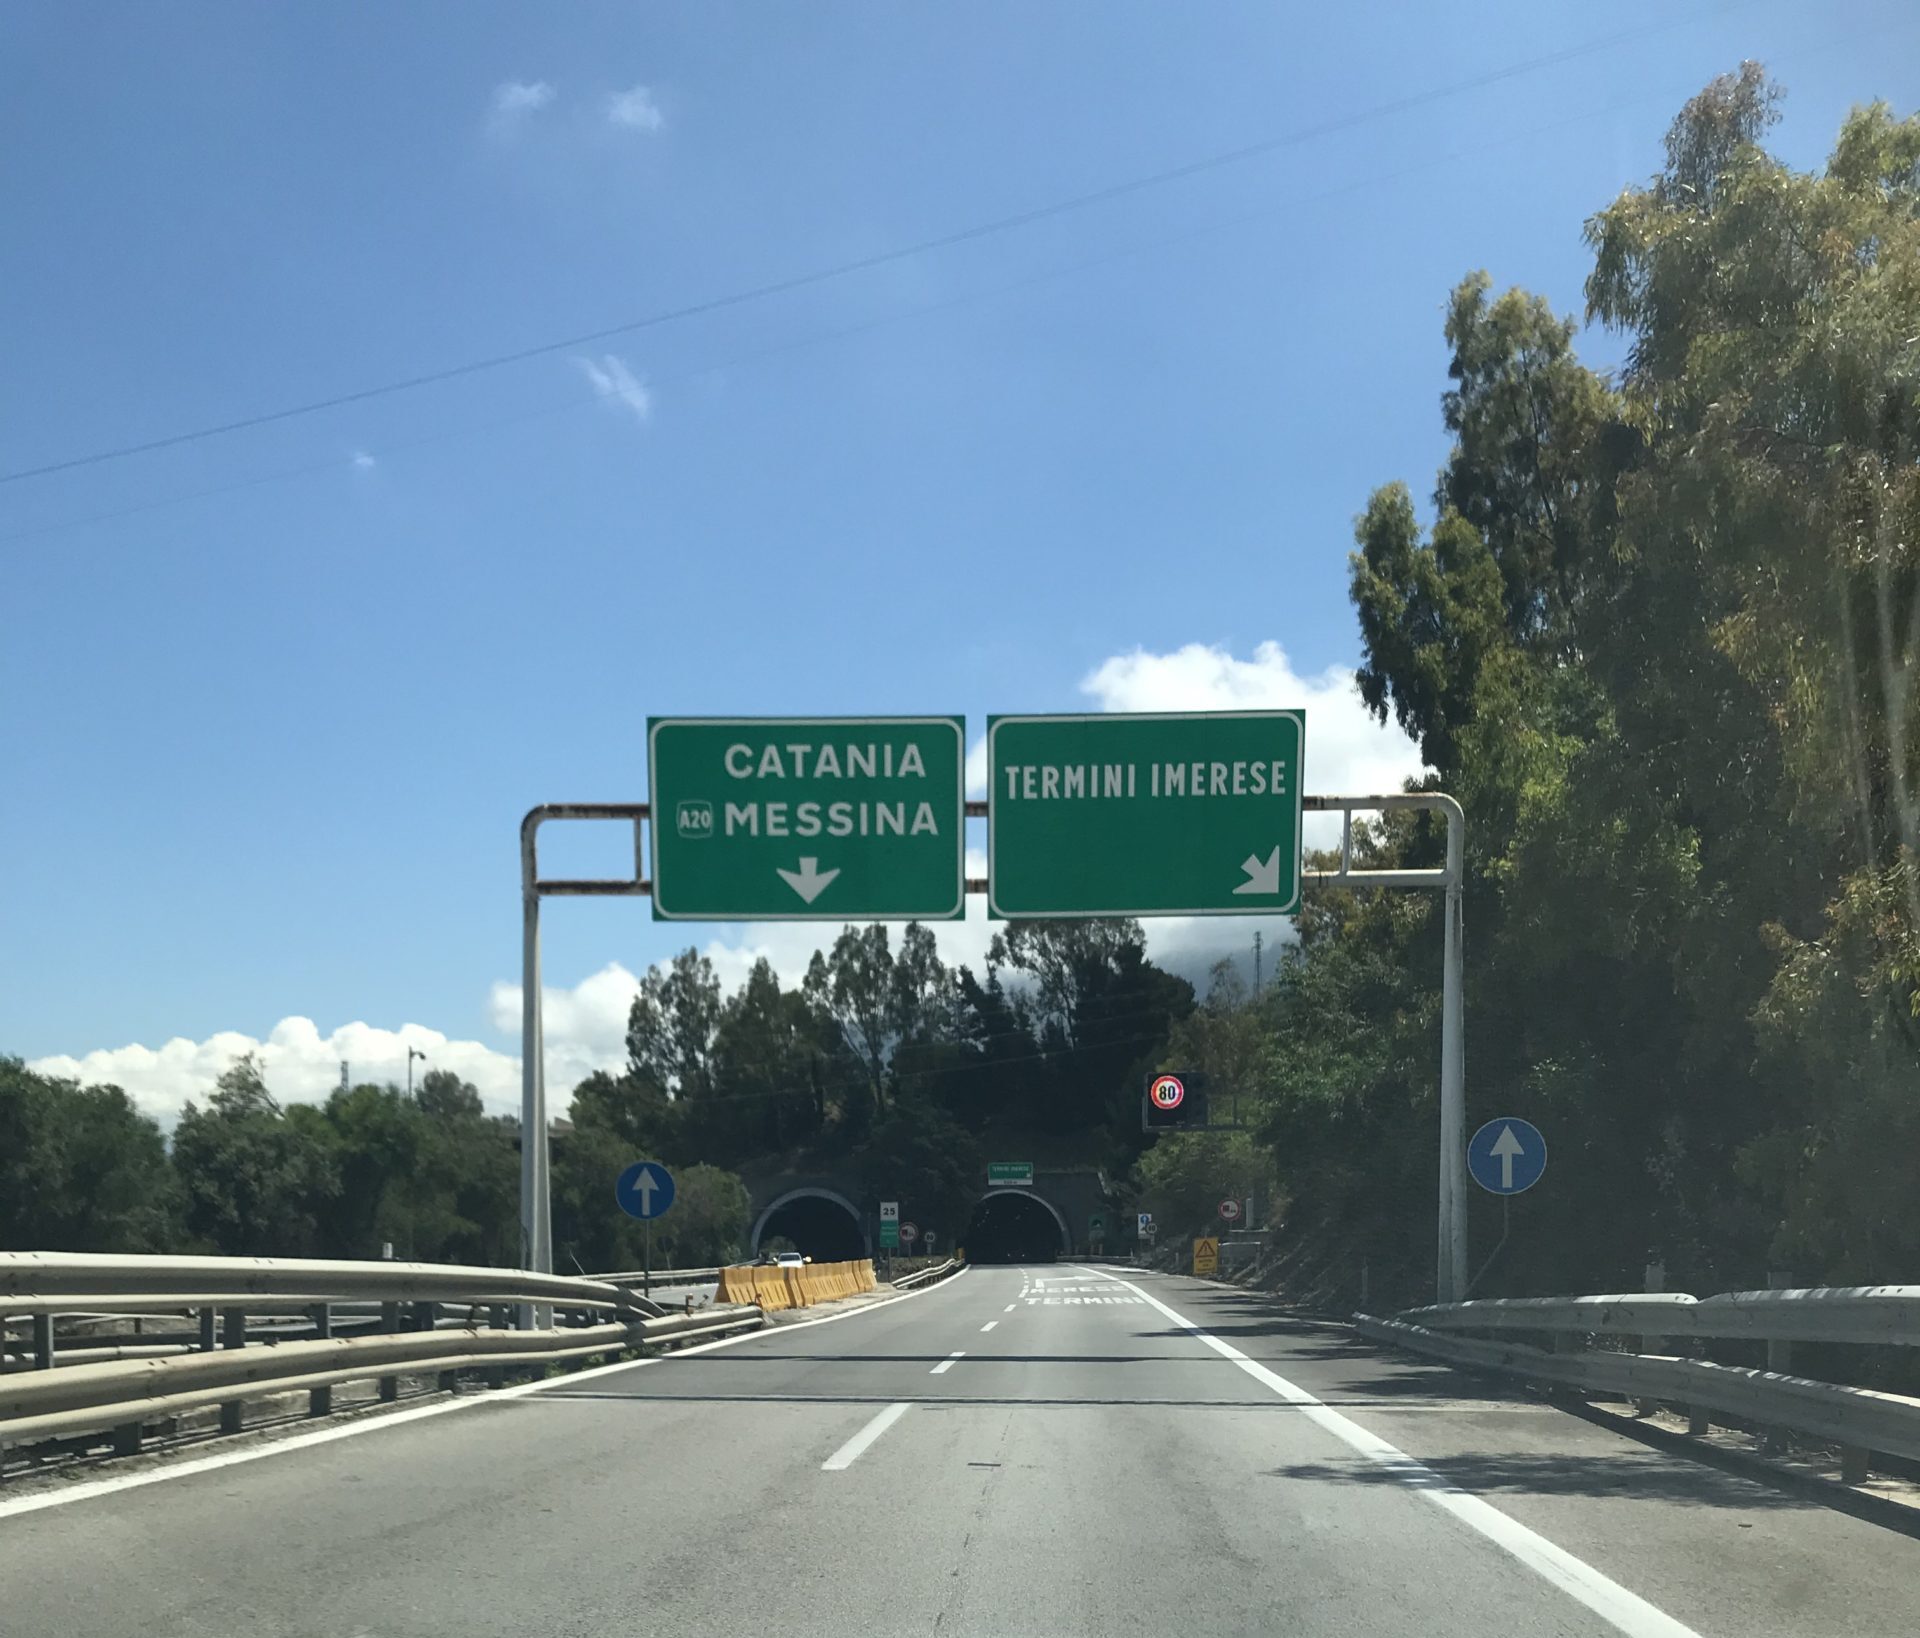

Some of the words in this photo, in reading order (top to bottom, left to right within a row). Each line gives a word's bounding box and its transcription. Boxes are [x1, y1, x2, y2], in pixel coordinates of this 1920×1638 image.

[724, 743, 926, 779] CATANIA
[1005, 765, 1137, 801] TERMINI
[1151, 761, 1286, 797] IMERESE
[680, 810, 711, 831] A20
[725, 802, 939, 837] MESSINA
[1159, 1085, 1176, 1100] 80
[883, 1208, 896, 1216] 25
